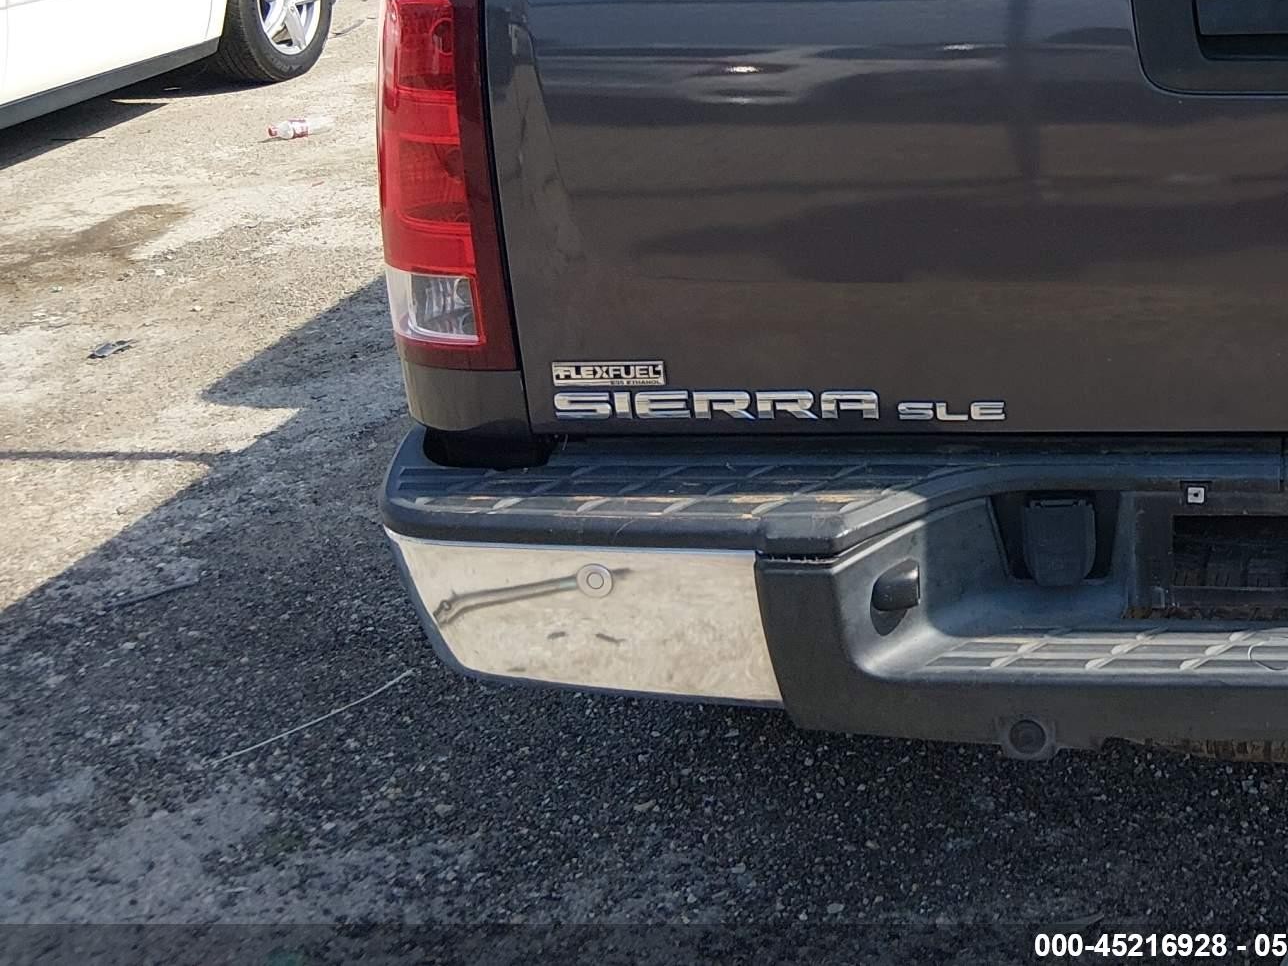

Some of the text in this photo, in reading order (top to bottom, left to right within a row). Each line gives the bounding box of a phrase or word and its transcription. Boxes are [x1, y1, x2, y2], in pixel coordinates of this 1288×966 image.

[556, 364, 661, 379] FLEXFUEL
[553, 390, 1006, 422] SIERRA SLE
